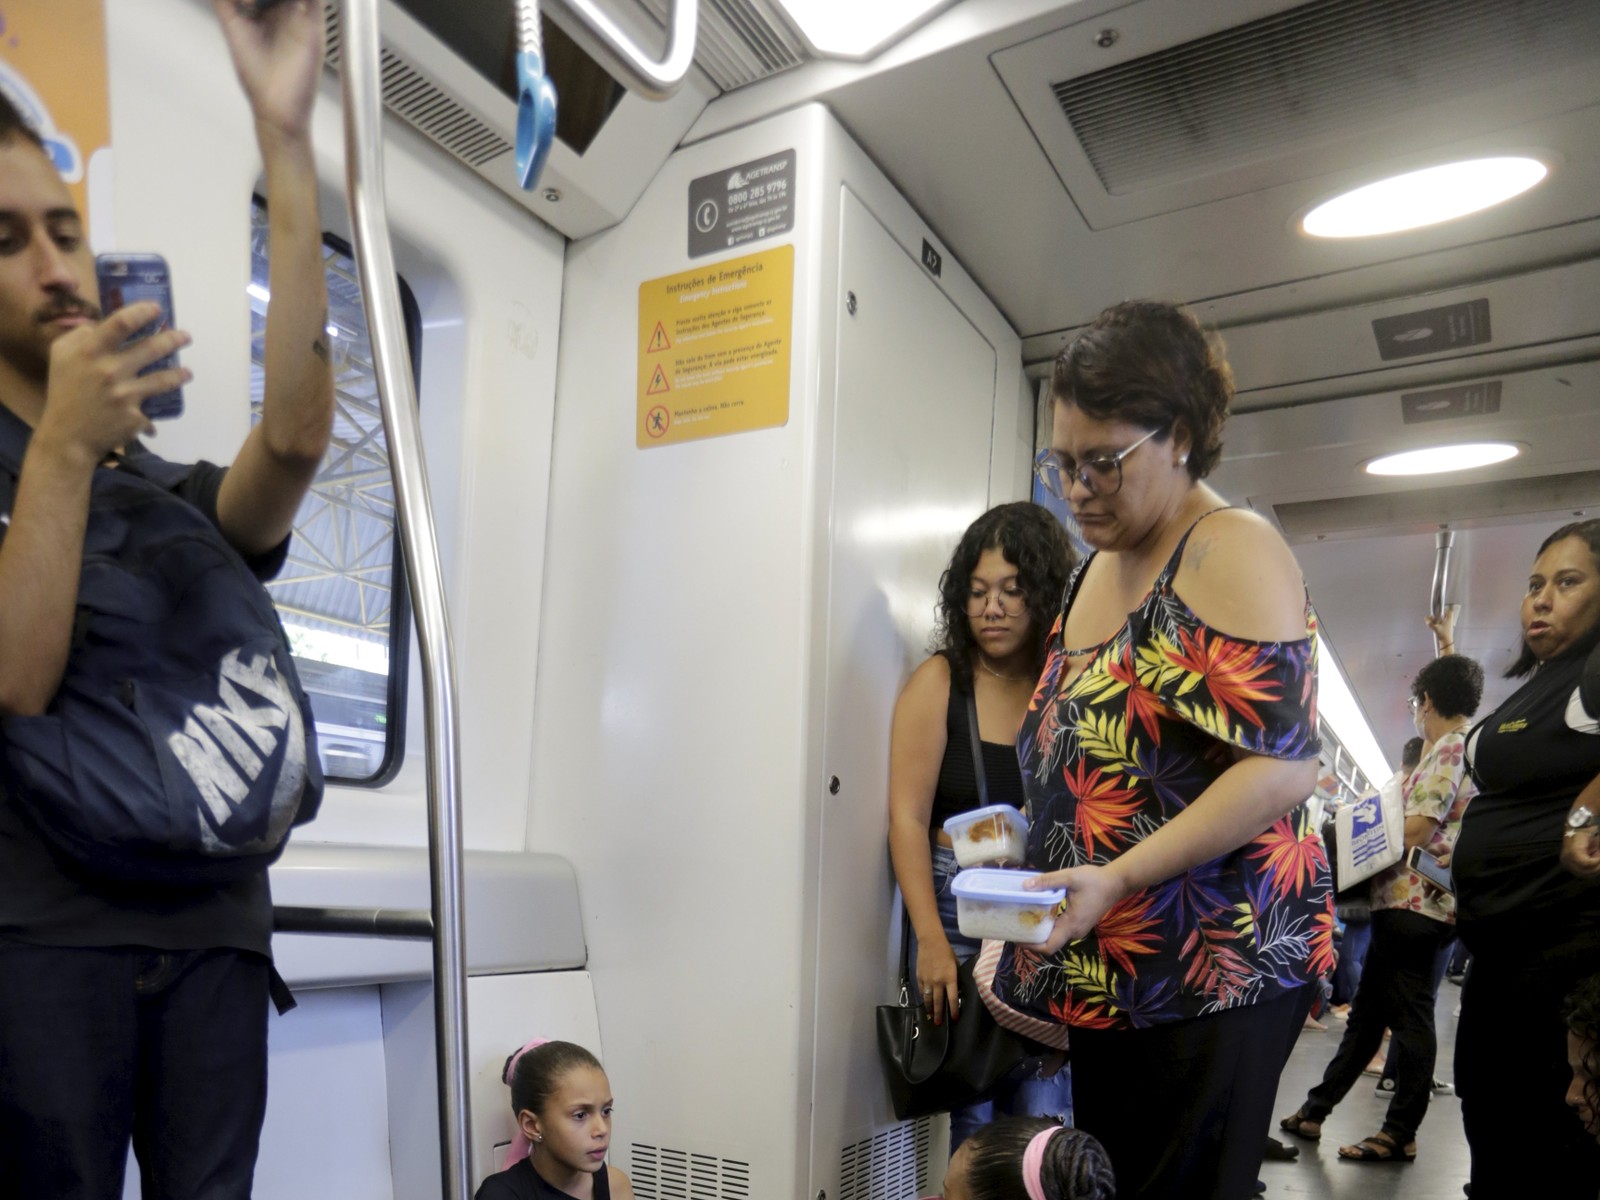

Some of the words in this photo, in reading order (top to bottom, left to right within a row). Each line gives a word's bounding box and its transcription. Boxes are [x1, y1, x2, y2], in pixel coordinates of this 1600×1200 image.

[745, 161, 787, 181] AGETRANSP
[728, 191, 748, 206] 0800
[750, 186, 765, 200] 285
[767, 179, 787, 194] 9796
[666, 278, 705, 294] Instruções
[707, 273, 717, 285] de
[718, 262, 763, 282] Emergência
[167, 648, 285, 827] NIKE
